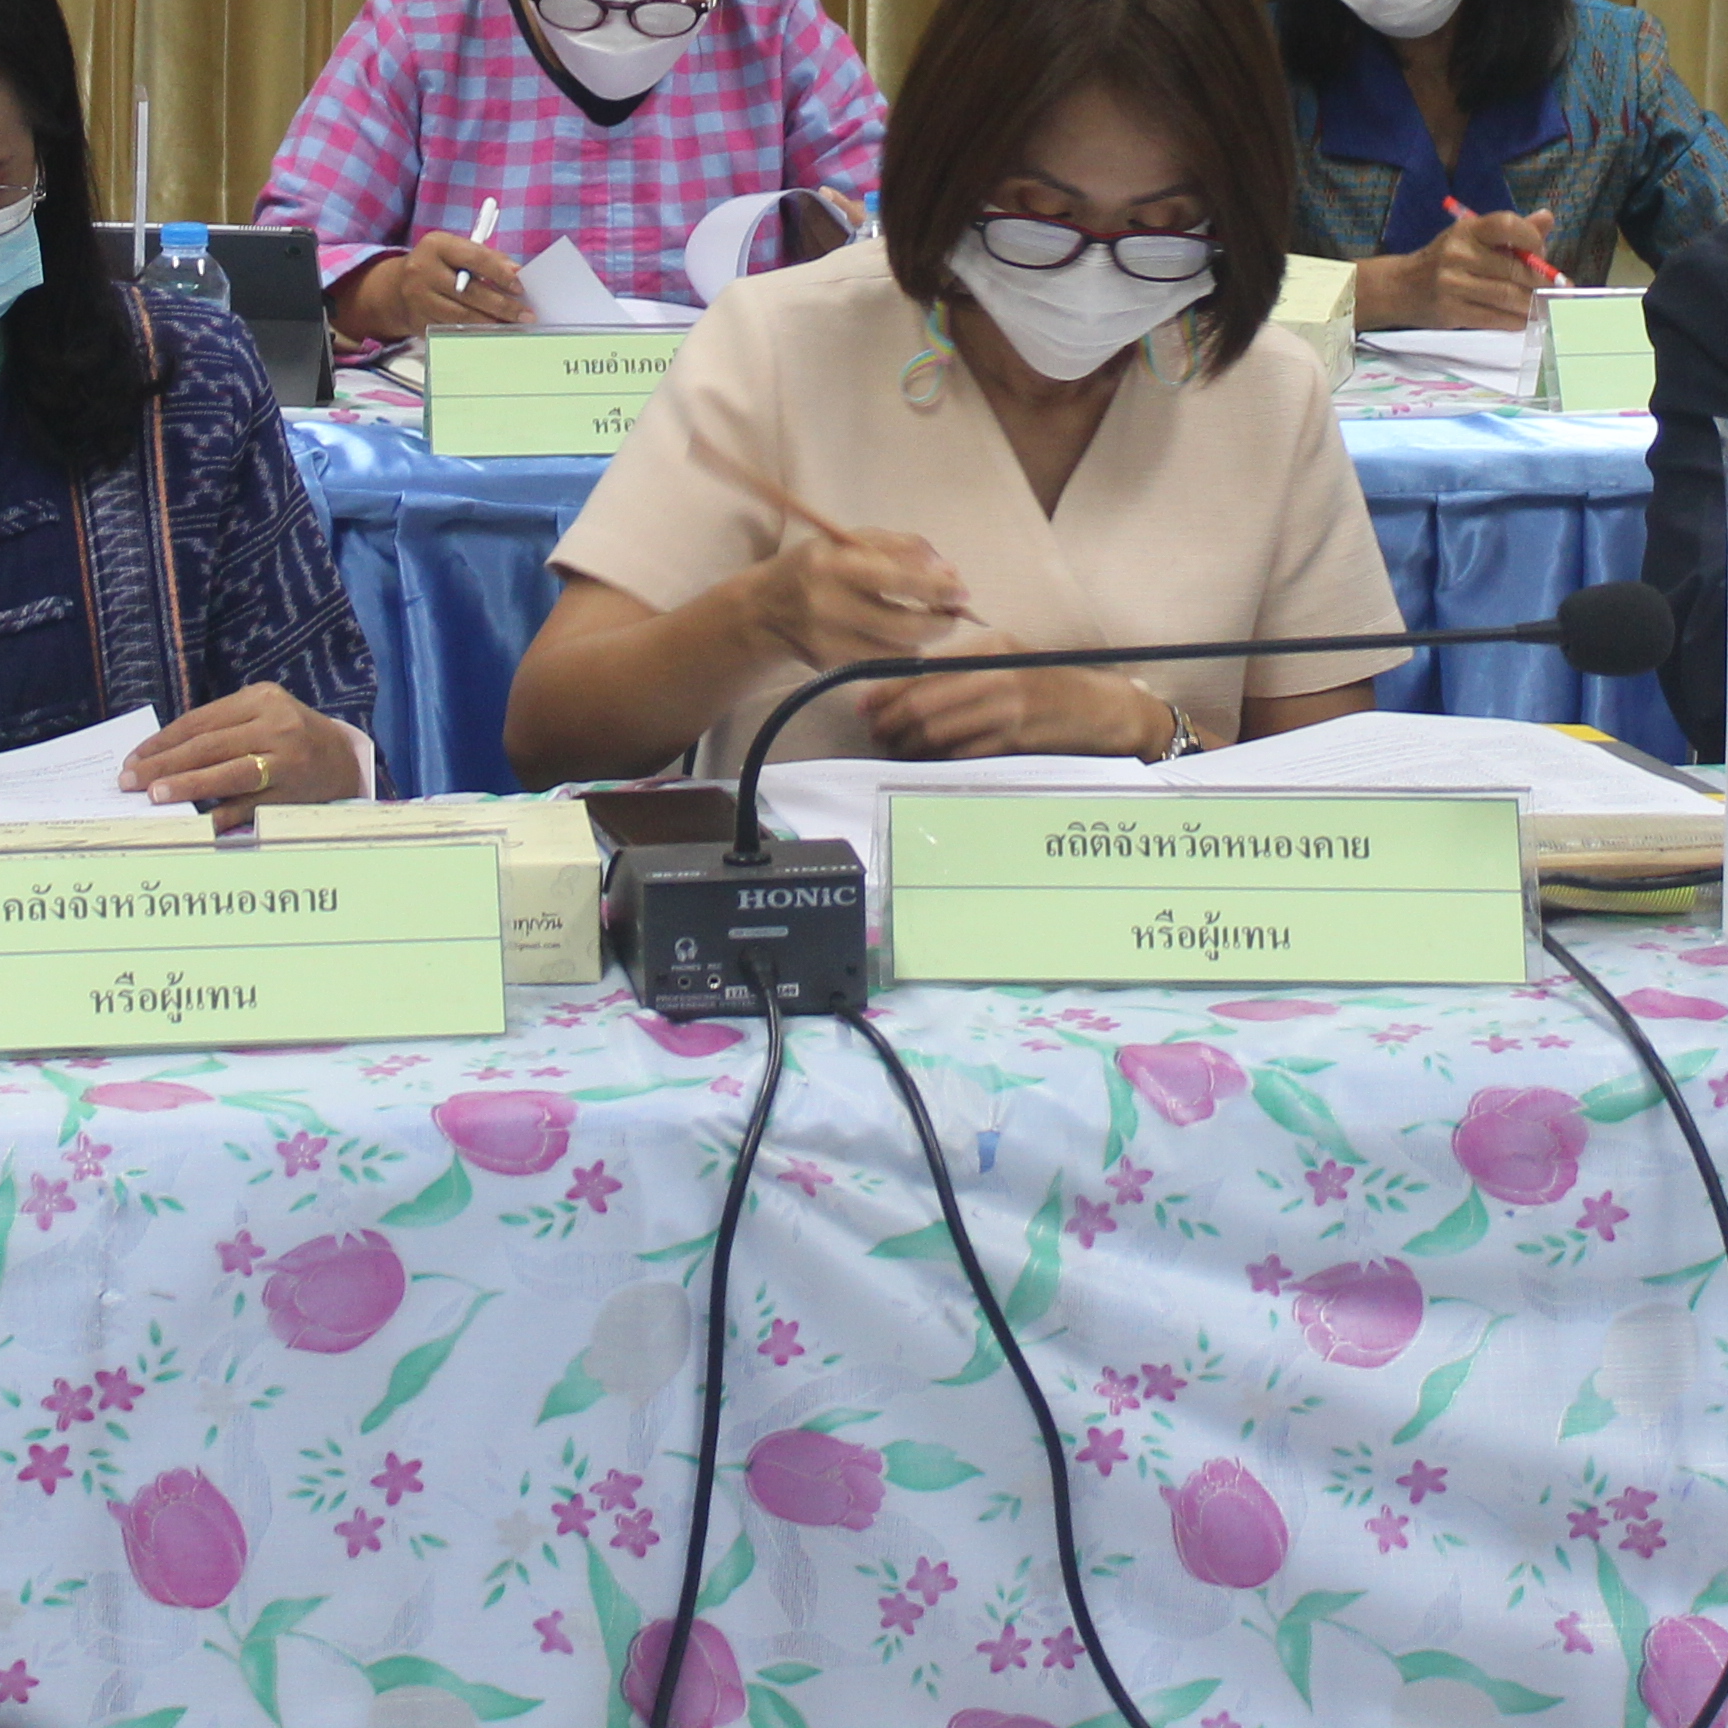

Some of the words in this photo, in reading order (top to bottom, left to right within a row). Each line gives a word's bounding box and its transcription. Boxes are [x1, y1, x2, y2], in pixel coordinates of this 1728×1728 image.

[563, 348, 677, 375] นายอำเภอ
[1044, 820, 1370, 860] สถิติจังหวัดหนองคาย
[1, 879, 339, 923] คลังจังหวัดหนองคาย
[1130, 908, 1292, 963] หรือผู้แทน
[88, 970, 258, 1025] หรือผู้แทน
